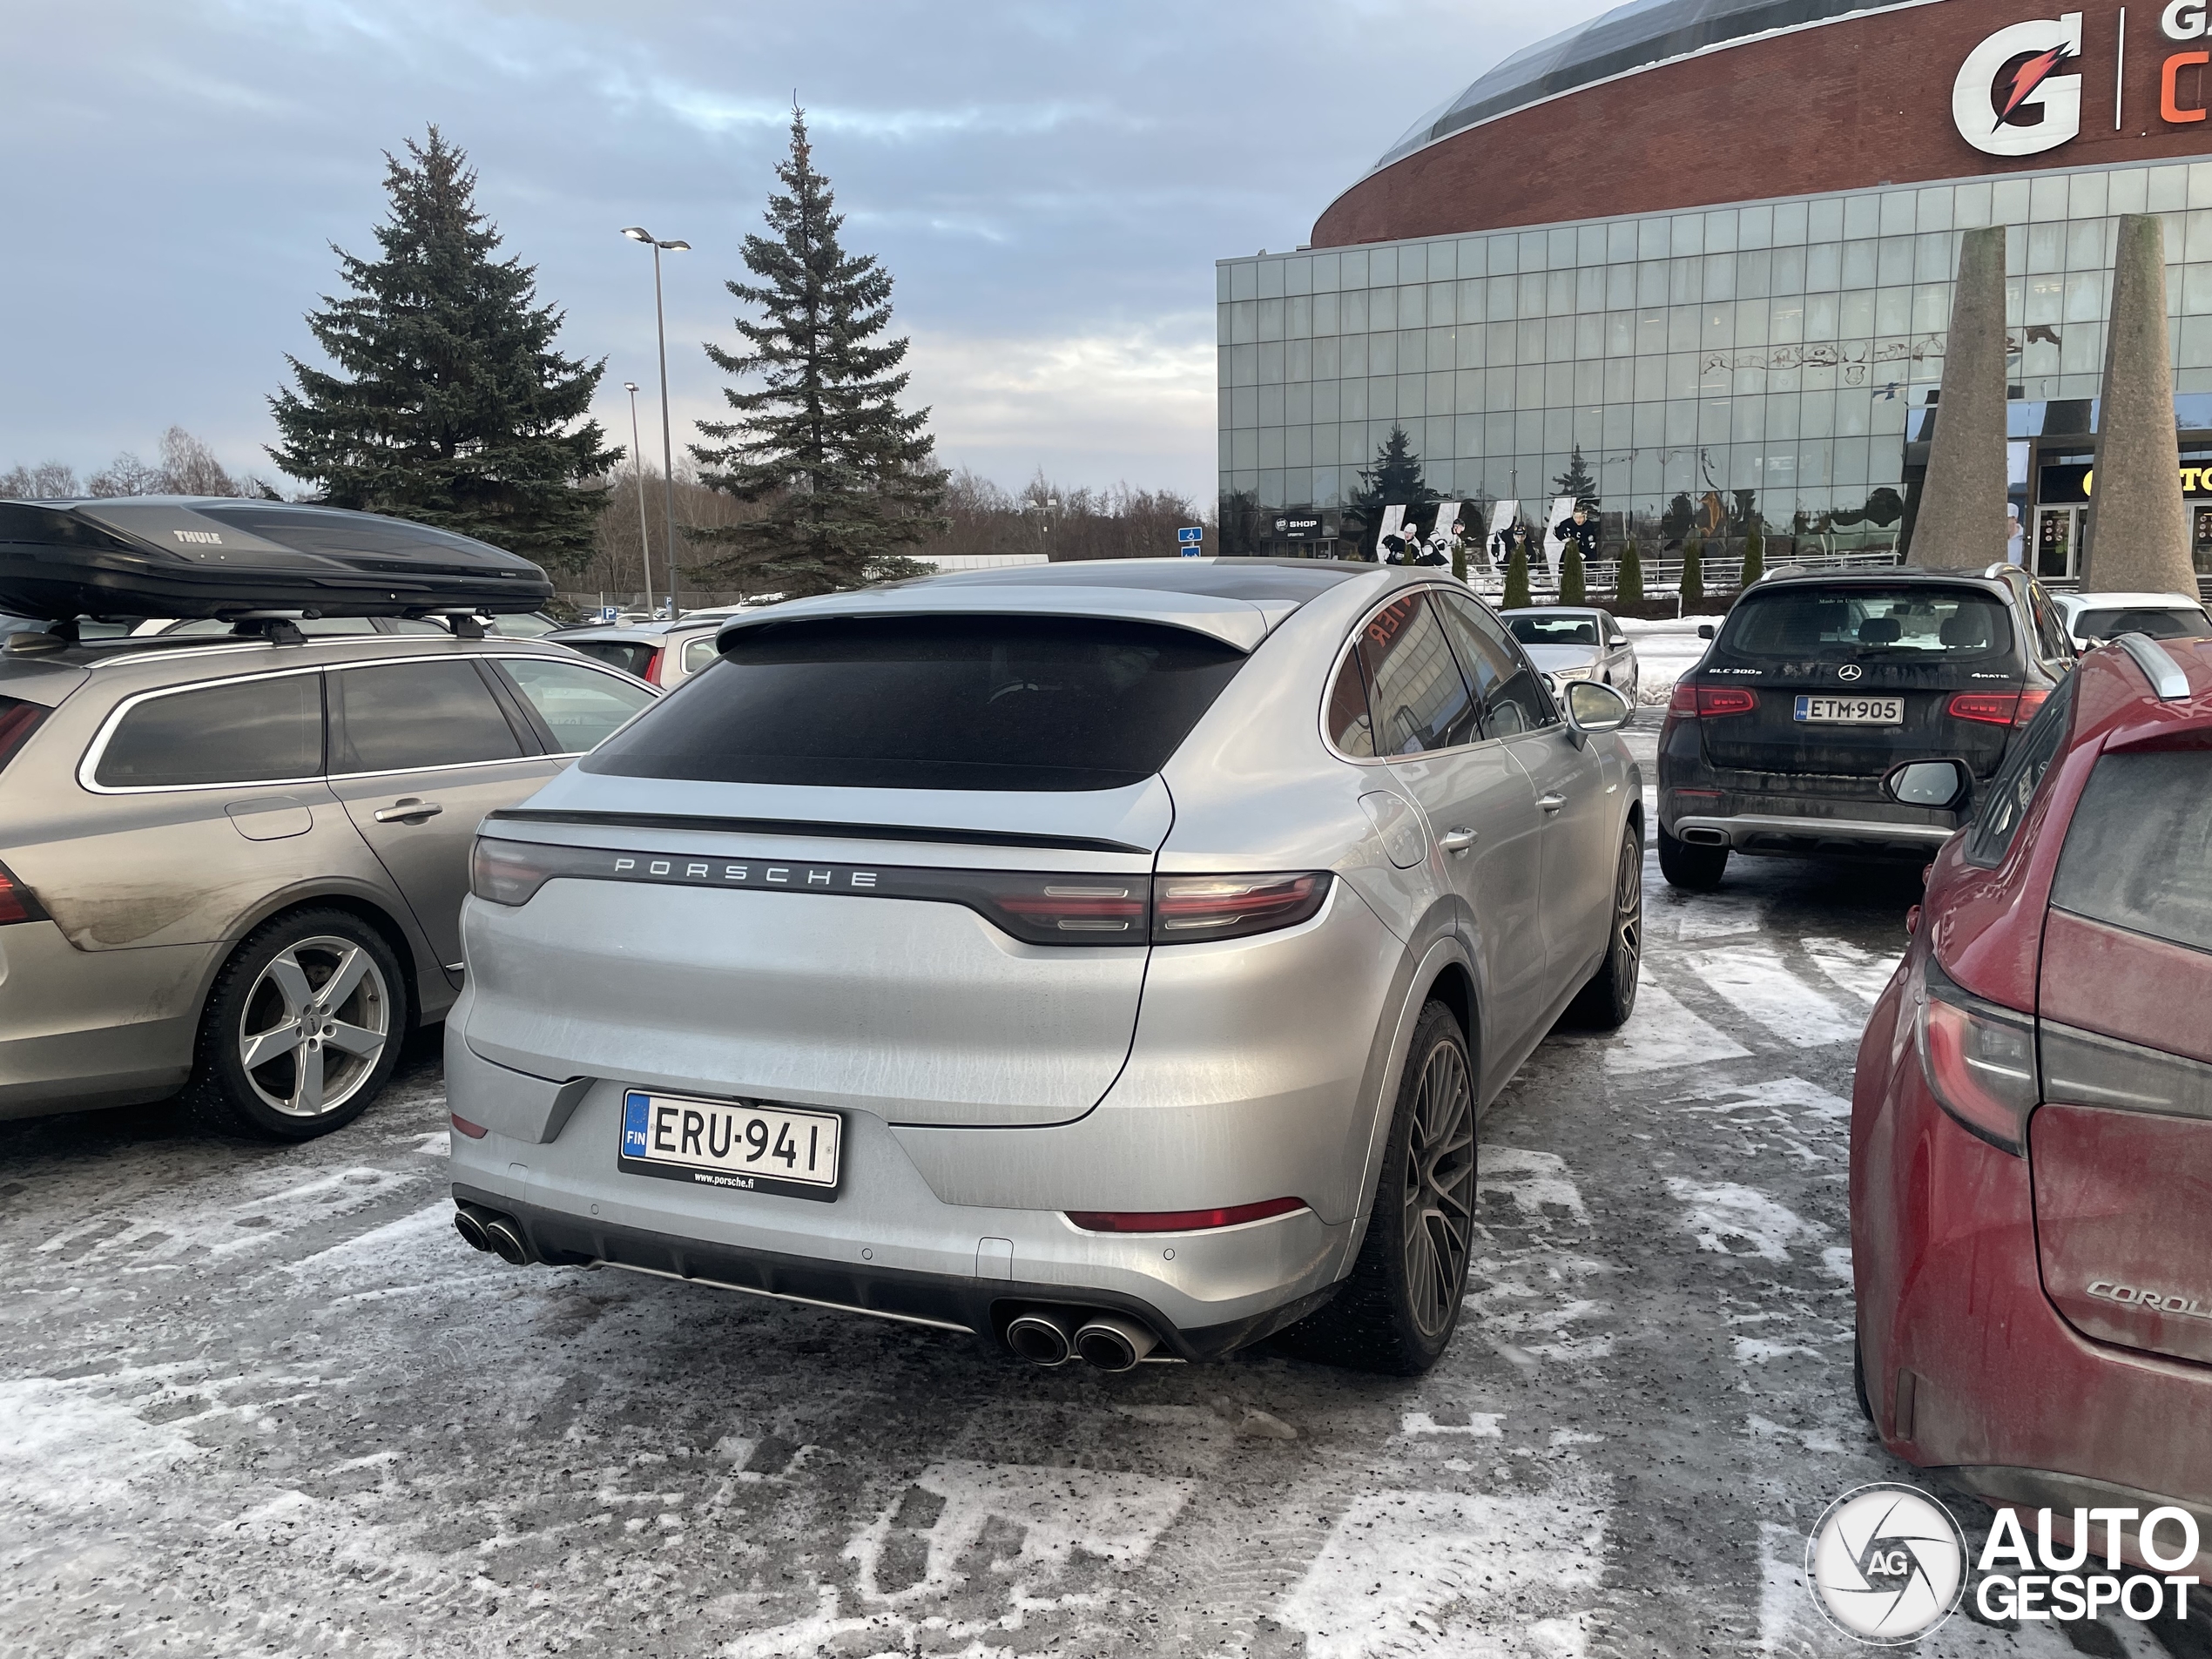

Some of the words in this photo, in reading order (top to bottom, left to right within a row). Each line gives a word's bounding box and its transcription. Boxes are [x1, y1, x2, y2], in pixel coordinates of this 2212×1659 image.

[2161, 0, 2212, 40] G
[172, 529, 223, 544] THULE
[665, 597, 672, 605] P
[605, 608, 615, 619] P
[1811, 700, 1897, 718] ETM-905
[614, 858, 878, 887] PORSCHE
[626, 1130, 646, 1146] FIN
[654, 1106, 819, 1171] ERU-941
[694, 1172, 754, 1189] www.porsche.fi
[2086, 1280, 2212, 1319] COROL
